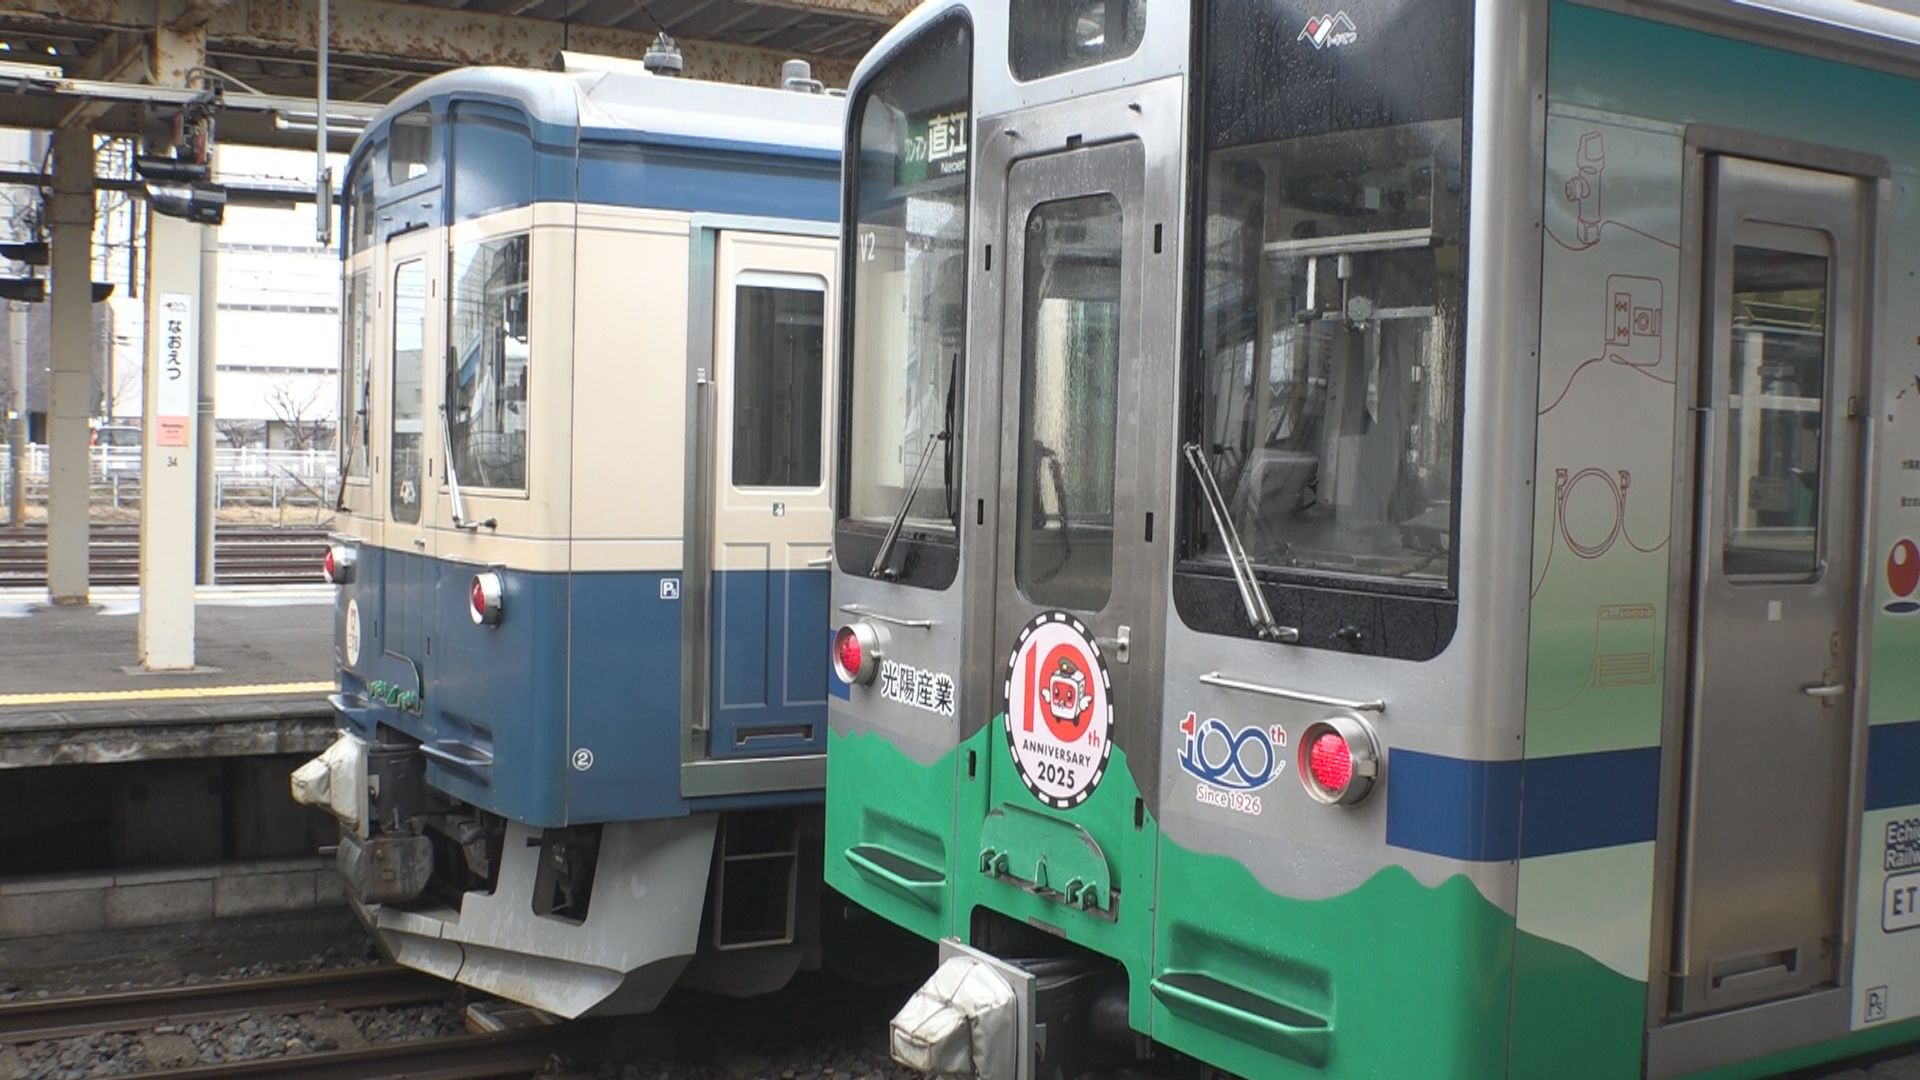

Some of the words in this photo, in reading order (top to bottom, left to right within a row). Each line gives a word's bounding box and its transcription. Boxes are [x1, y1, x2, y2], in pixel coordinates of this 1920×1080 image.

[928, 112, 967, 163] 直江
[860, 231, 876, 262] V2
[167, 319, 182, 381] なおえつ
[881, 661, 954, 716] 光陽産業
[1022, 738, 1091, 768] ANNIVERSARY
[1037, 761, 1076, 789] 2025
[1197, 785, 1228, 807] Since
[1229, 792, 1261, 814] 1926
